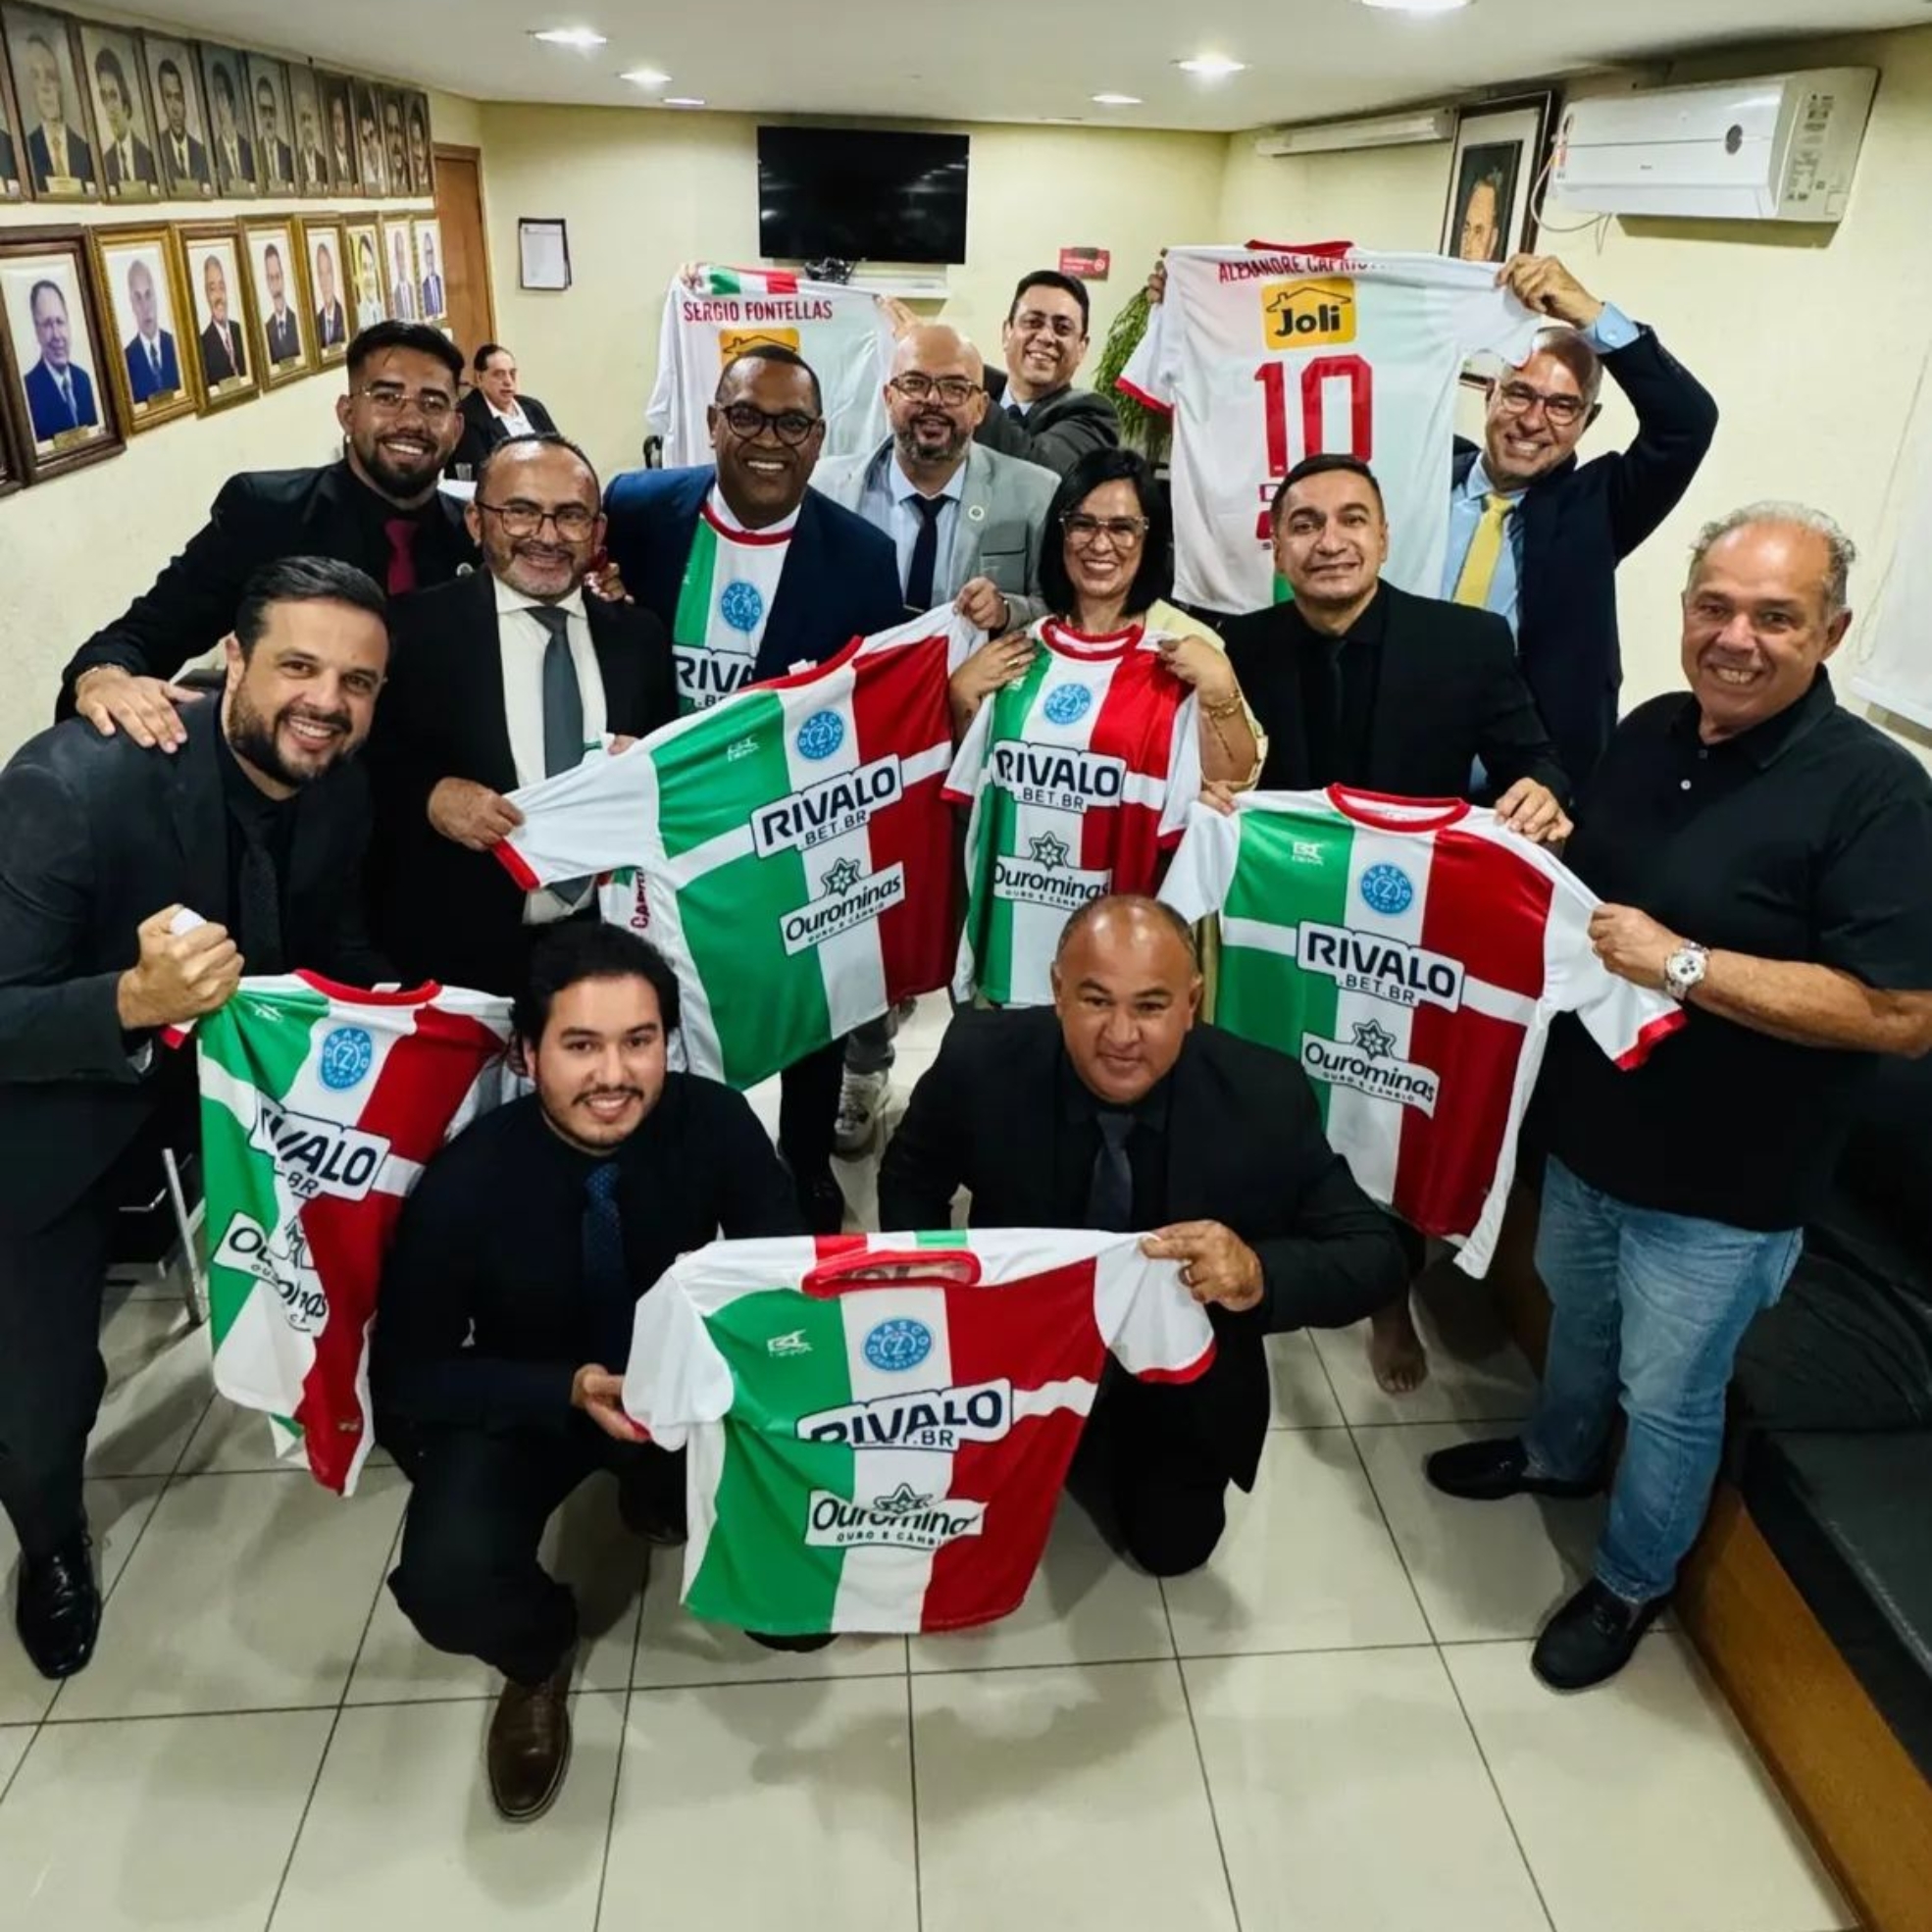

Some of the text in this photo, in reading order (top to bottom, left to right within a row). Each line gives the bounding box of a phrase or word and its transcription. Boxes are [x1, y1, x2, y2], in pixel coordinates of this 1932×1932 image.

[683, 300, 833, 322] SERGIO FONTELLAS
[1275, 304, 1341, 337] Joli
[1254, 354, 1373, 478] 10
[995, 748, 1121, 797] RIVALO
[762, 766, 895, 846] RIVALO
[786, 875, 901, 941] Ourominas
[1307, 931, 1456, 999] RIVALO
[1304, 1042, 1435, 1102] Ourominas
